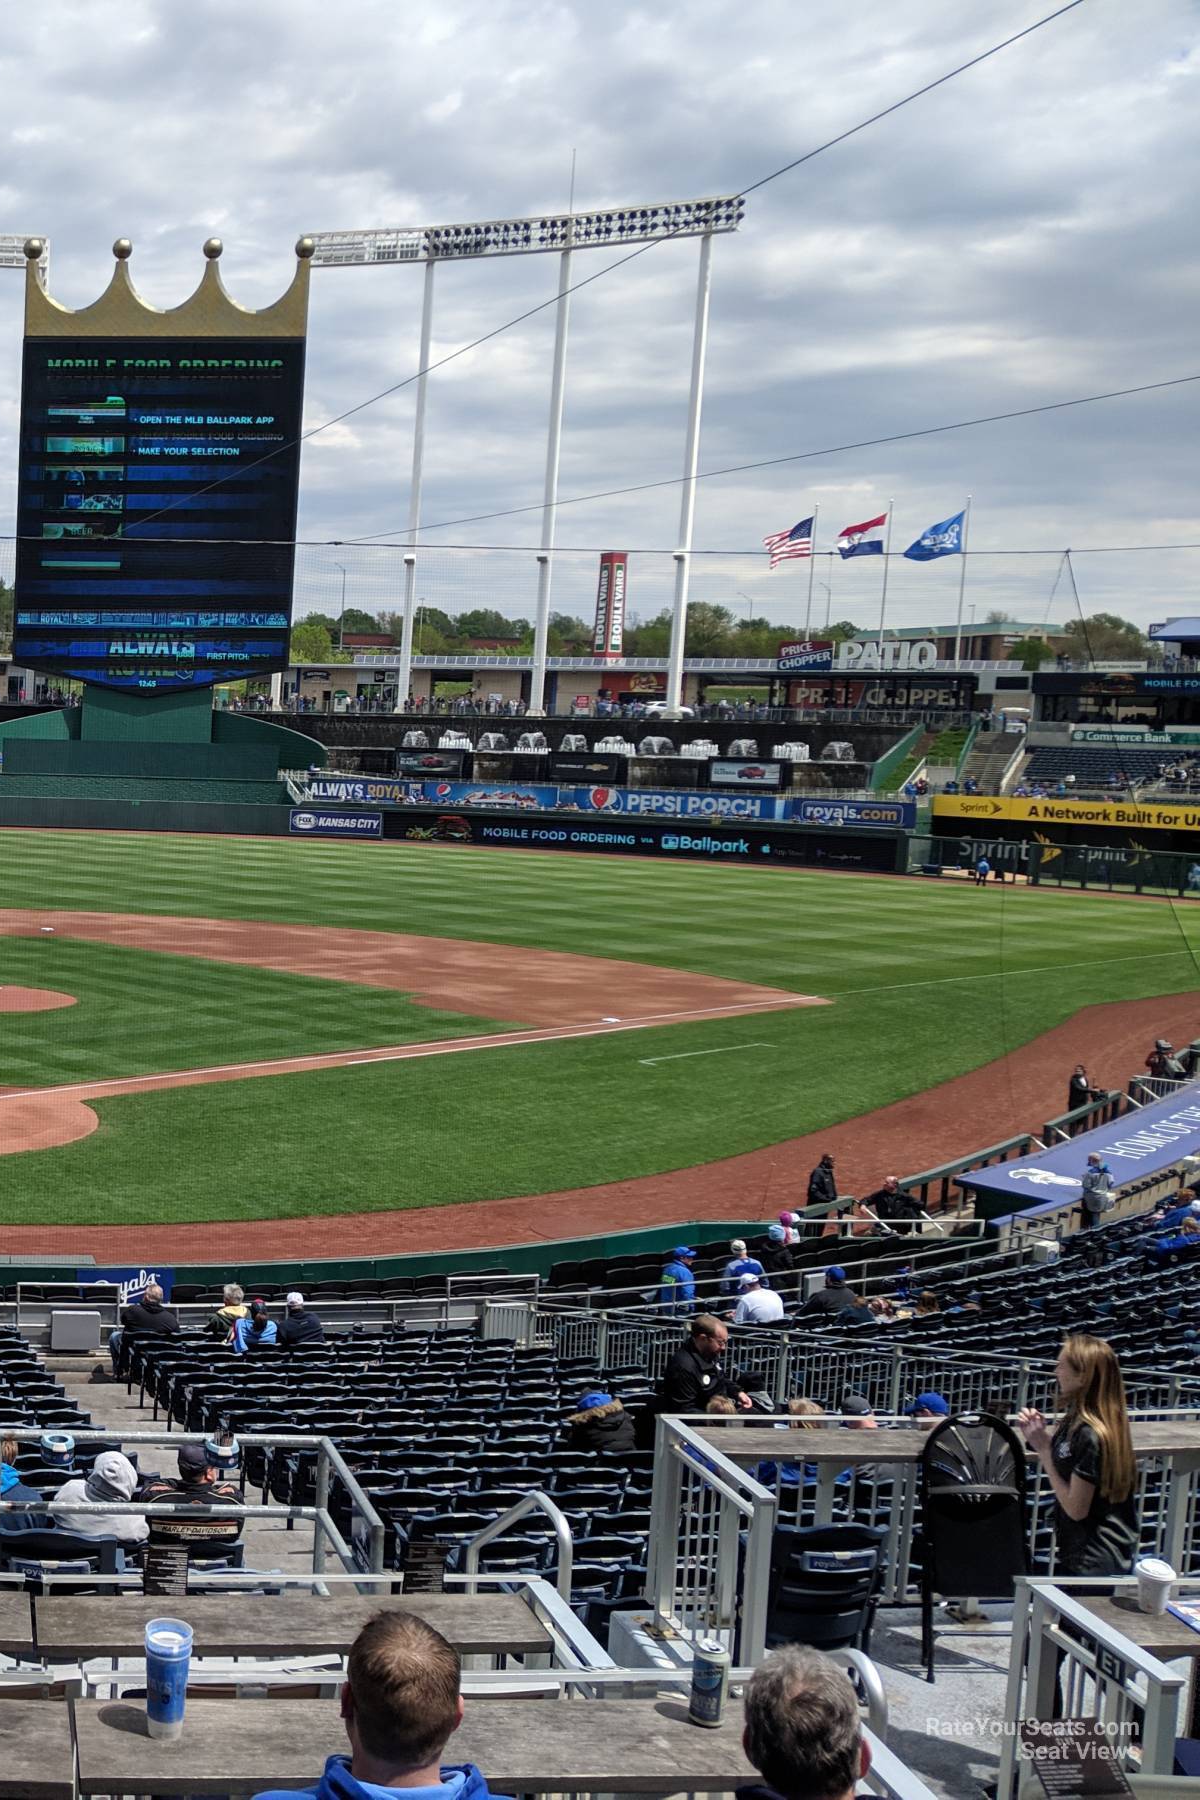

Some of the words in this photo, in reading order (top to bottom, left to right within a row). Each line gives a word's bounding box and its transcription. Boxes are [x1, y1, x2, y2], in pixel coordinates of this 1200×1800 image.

[140, 415, 162, 424] OPEN
[165, 415, 182, 424] THE
[185, 416, 204, 424] MLB
[207, 416, 253, 424] BALLPARK
[256, 416, 274, 424] APP
[138, 447, 161, 456] MAKE
[163, 447, 188, 456] YOUR
[191, 447, 240, 456] SELECTION
[594, 569, 609, 645] BOULEVARD
[610, 569, 624, 645] BOULEVARD
[206, 652, 227, 661] FIRST
[781, 641, 813, 657] PRICE
[779, 651, 832, 670] CHOPPER
[1086, 731, 1142, 743] Commerce
[1144, 733, 1172, 743] Bank
[311, 782, 364, 798] ALWAYS
[627, 793, 681, 812] PEPSI
[688, 795, 762, 817] PORCH
[806, 805, 898, 821] royals.com
[960, 802, 990, 814] Sprint
[298, 816, 313, 825] FOX
[318, 817, 357, 828] KANSAS
[358, 818, 380, 829] CITY
[1028, 806, 1040, 818] A
[1043, 806, 1111, 822] Network
[1115, 810, 1152, 824] Built
[1156, 811, 1180, 826] for
[483, 826, 529, 839] MOBILE
[531, 829, 567, 841] FOOD
[570, 831, 636, 845] ORDERING
[680, 835, 749, 854] Ballpark
[1097, 1130, 1180, 1159] HOME
[1150, 1119, 1199, 1134] OF
[1102, 1655, 1120, 1680] E1
